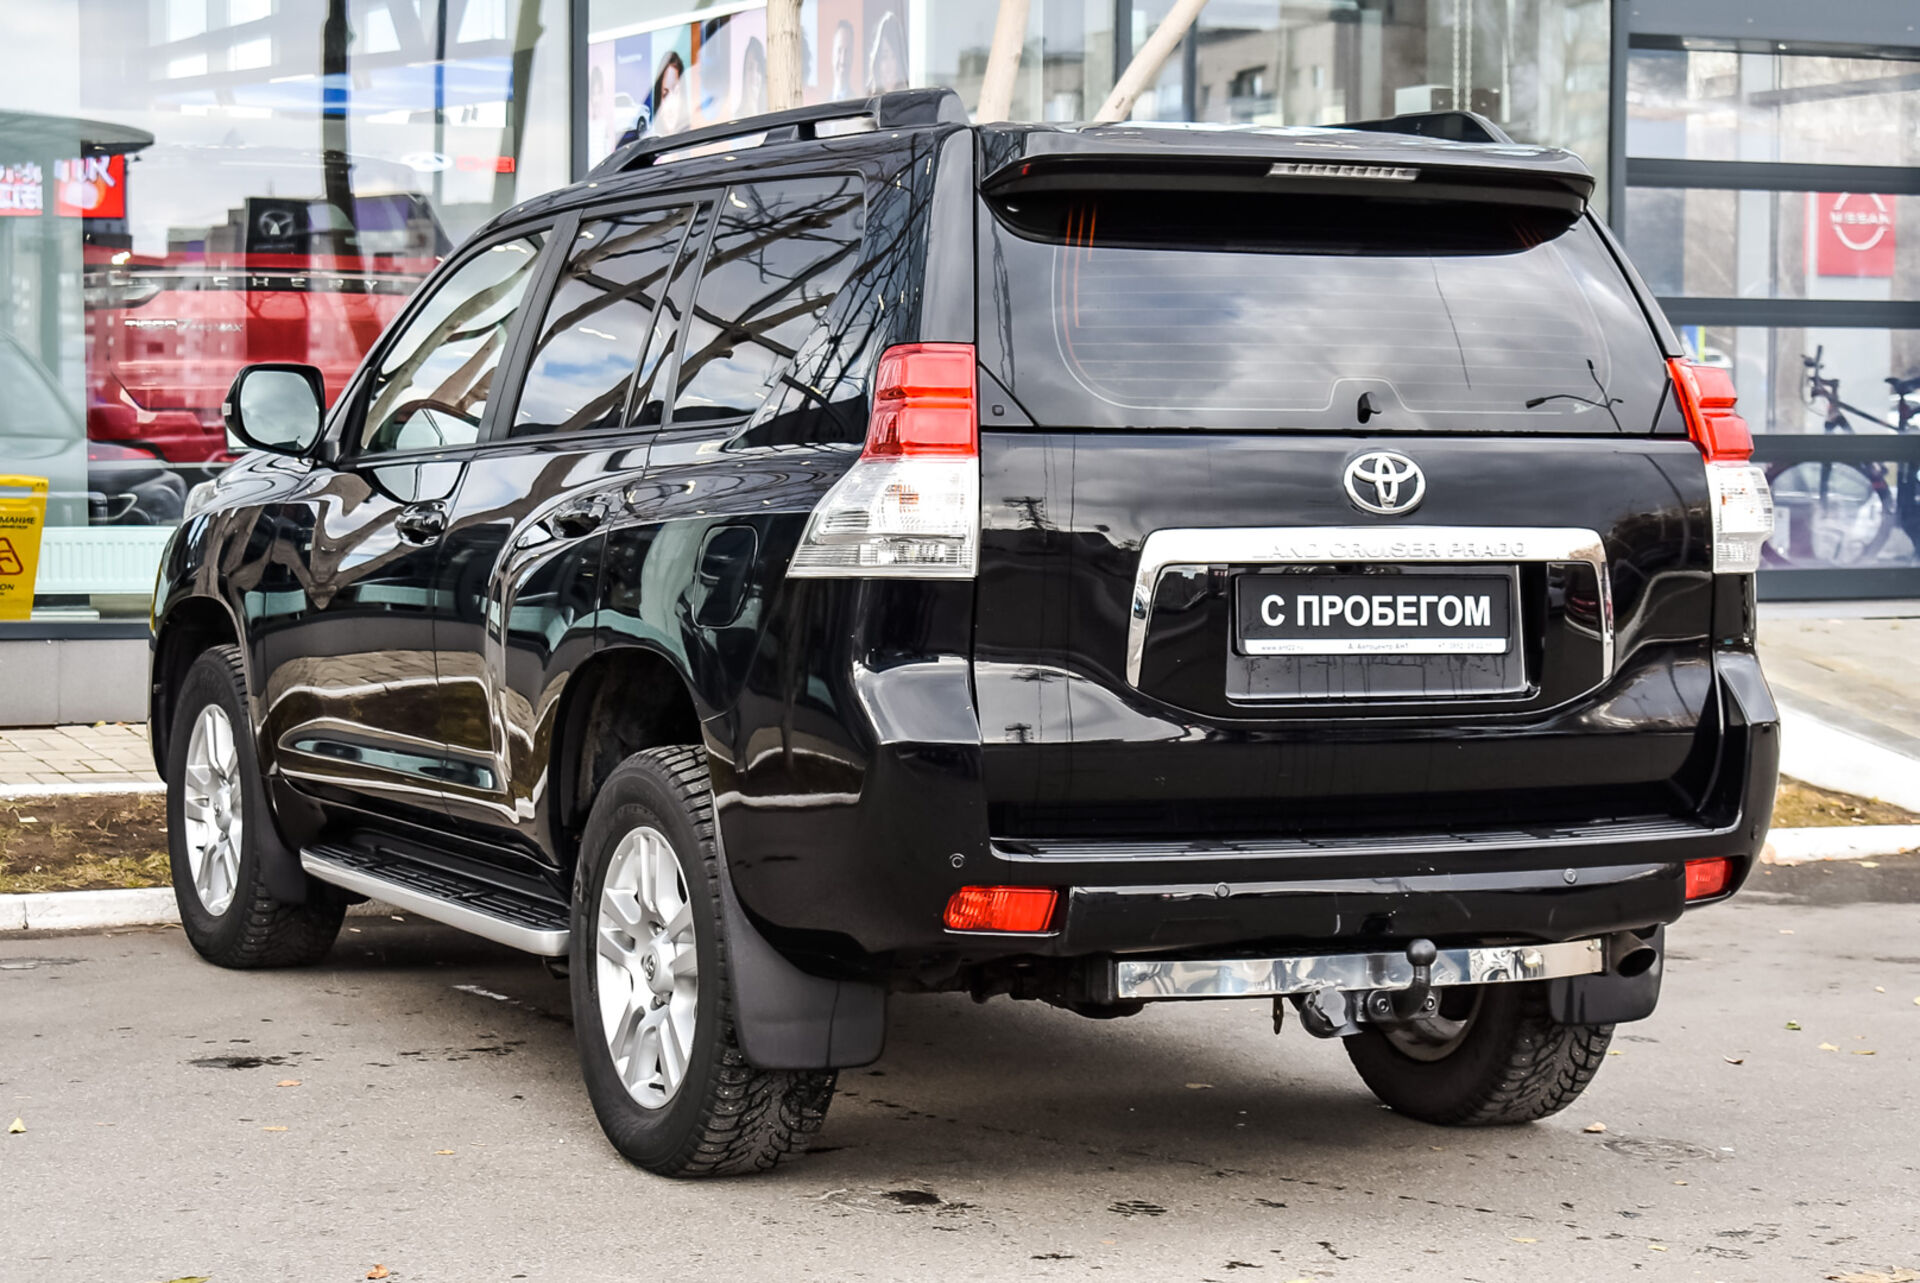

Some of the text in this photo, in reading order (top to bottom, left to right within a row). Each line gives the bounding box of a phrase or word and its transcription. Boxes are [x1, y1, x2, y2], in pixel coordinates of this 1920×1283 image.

[1830, 211, 1889, 225] NISSAN
[213, 276, 378, 290] CHERY
[1328, 543, 1441, 558] CRUISER
[1448, 543, 1527, 558] PRADO
[1261, 594, 1491, 627] С ПРОБЕГОМ
